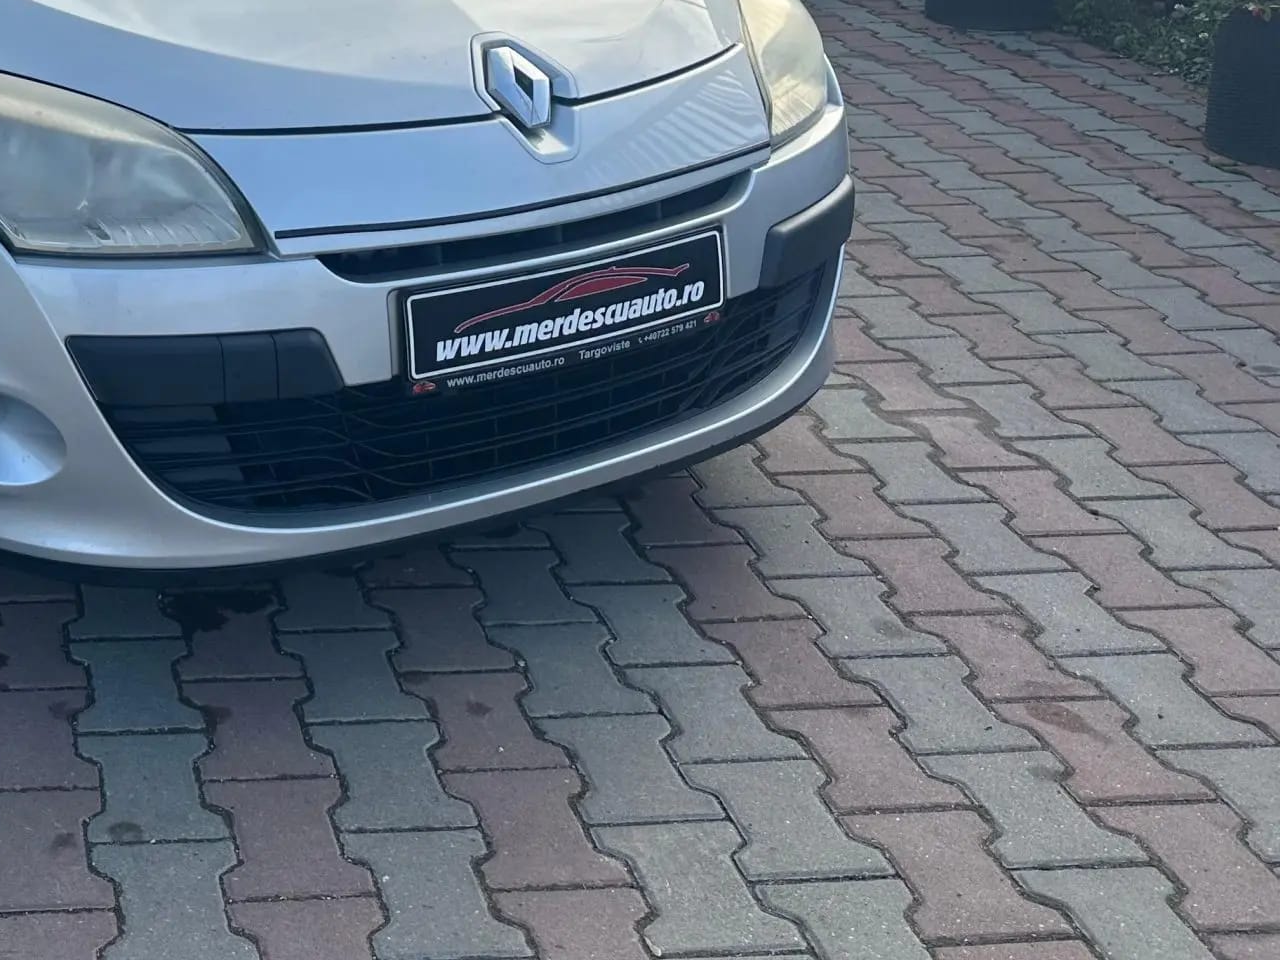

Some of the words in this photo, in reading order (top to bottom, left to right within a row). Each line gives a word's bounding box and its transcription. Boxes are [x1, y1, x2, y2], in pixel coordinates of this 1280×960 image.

[436, 280, 705, 362] www.merdescuauto.ro
[446, 355, 565, 388] www.merdescuauto.ro
[578, 338, 631, 361] Targoviste
